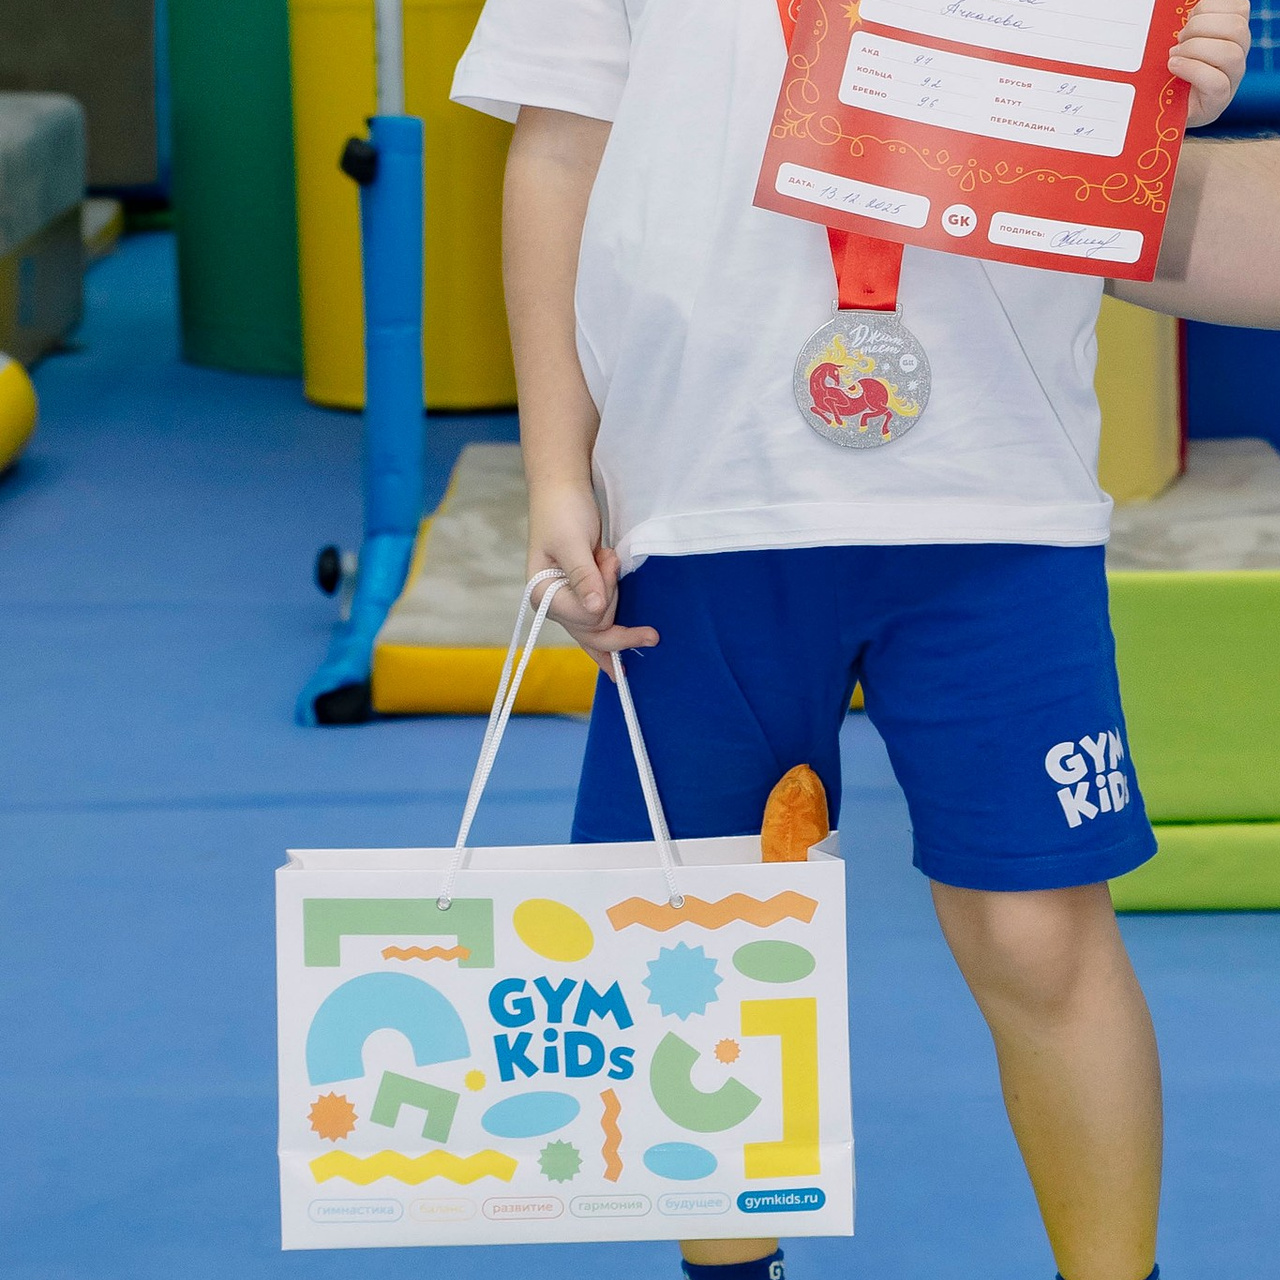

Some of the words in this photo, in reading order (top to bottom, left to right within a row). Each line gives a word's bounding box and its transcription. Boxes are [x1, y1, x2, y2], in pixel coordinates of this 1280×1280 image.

[861, 47, 880, 57] АКД
[856, 65, 893, 80] КОЛЬЦА
[998, 77, 1033, 89] БРУСЬЯ
[852, 84, 888, 99] БРЕВНО
[994, 96, 1023, 107] БАТУТ
[990, 115, 1057, 133] ПЕРЕКЛАДИНА
[788, 176, 816, 189] ДАТА:
[947, 212, 971, 228] GK
[999, 224, 1046, 238] ПОДПИСЬ:
[1045, 726, 1125, 785] GYM
[488, 976, 635, 1030] GYM
[578, 1200, 643, 1212] гармония
[665, 1197, 723, 1211] будущее
[744, 1192, 819, 1209] gymkids.ru
[316, 1205, 395, 1216] гимнастика
[492, 1202, 554, 1215] развитие
